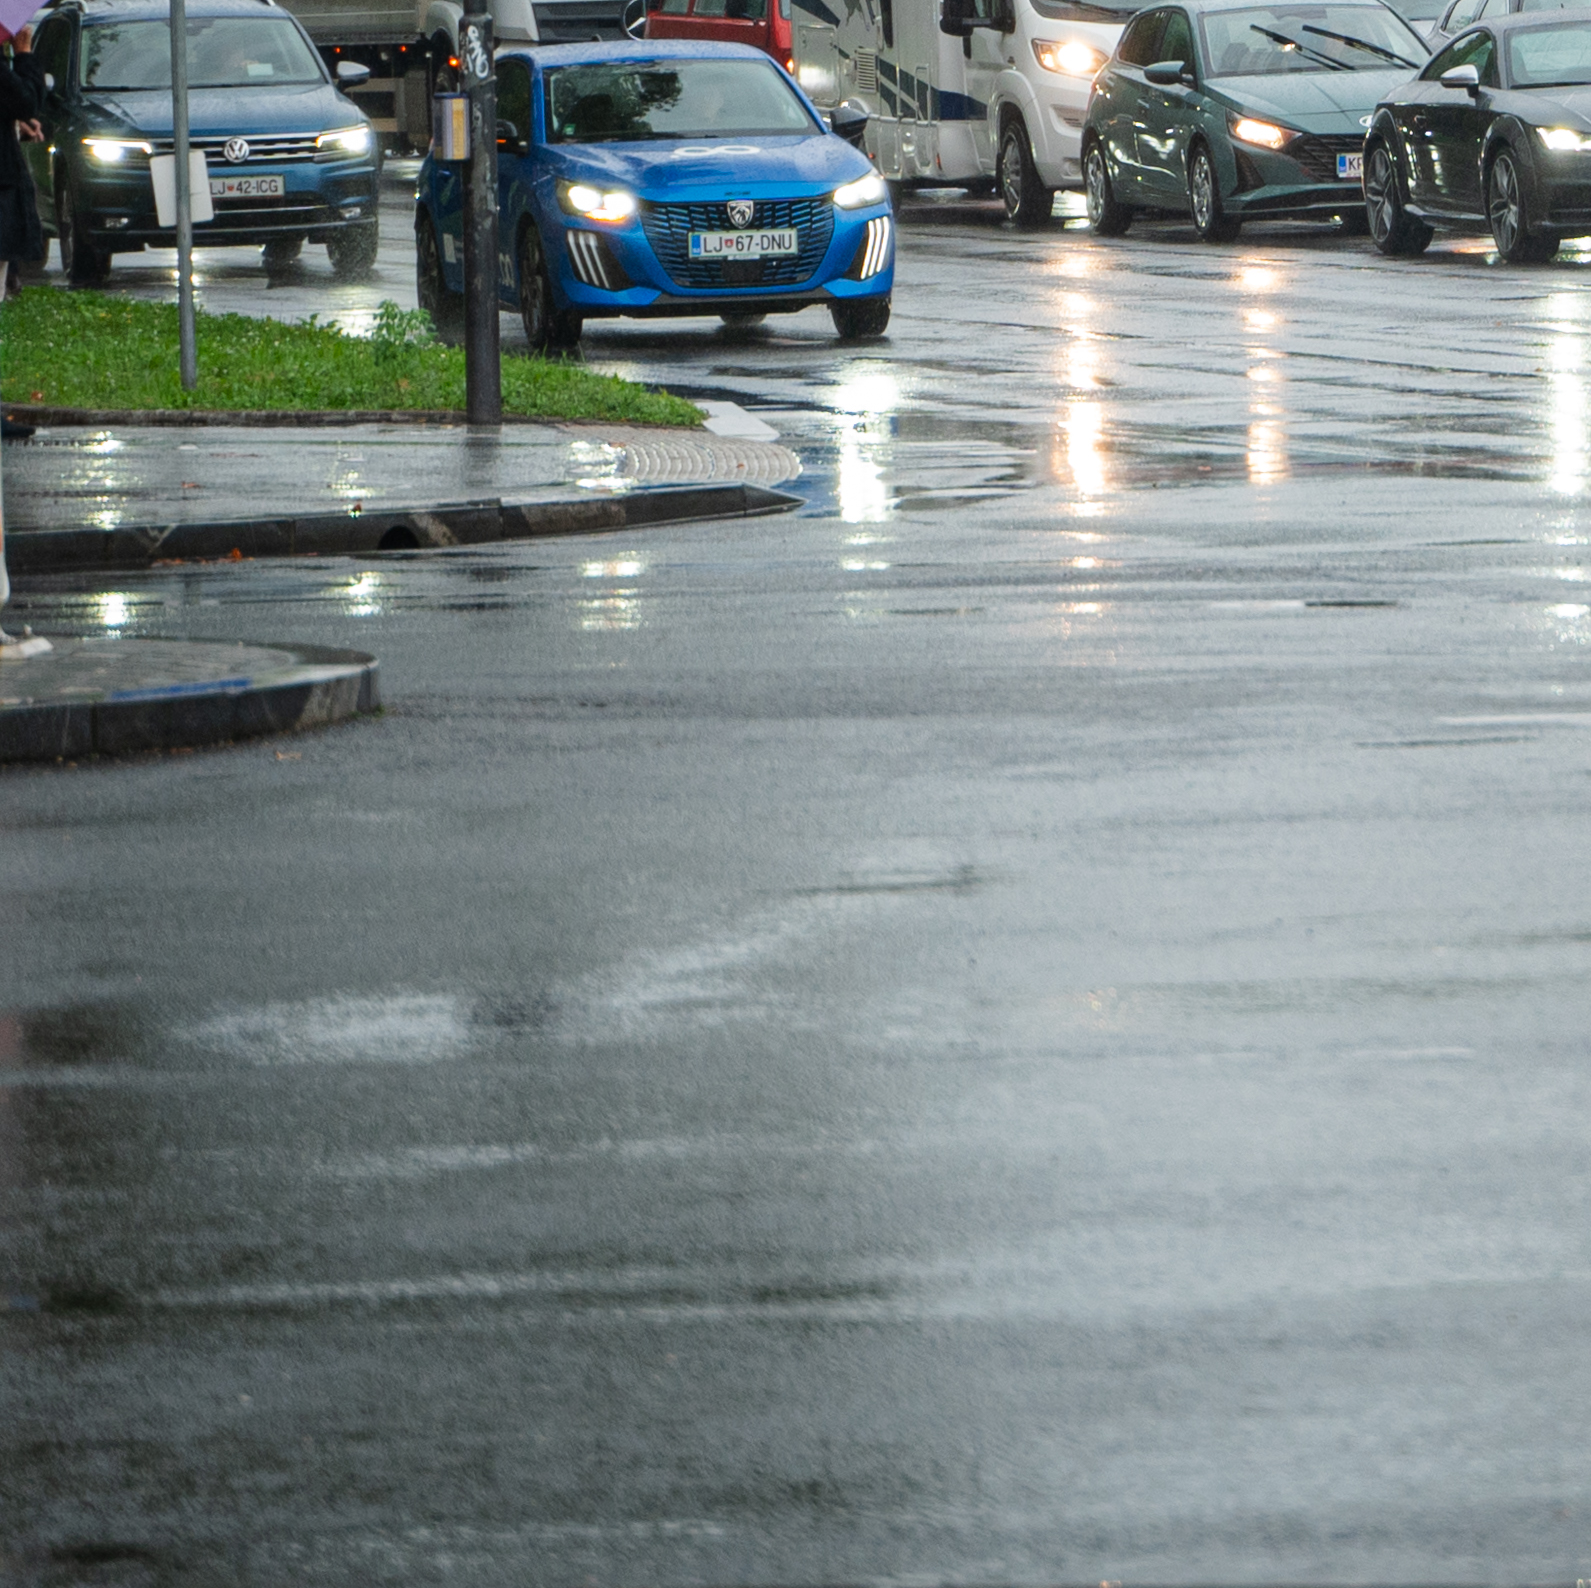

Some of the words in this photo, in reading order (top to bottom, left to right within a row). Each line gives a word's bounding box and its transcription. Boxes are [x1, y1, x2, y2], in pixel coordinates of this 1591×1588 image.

[209, 181, 226, 195] LJ
[236, 179, 278, 194] 42-ICG
[703, 236, 723, 254] LJ
[735, 233, 792, 252] 67-DNU
